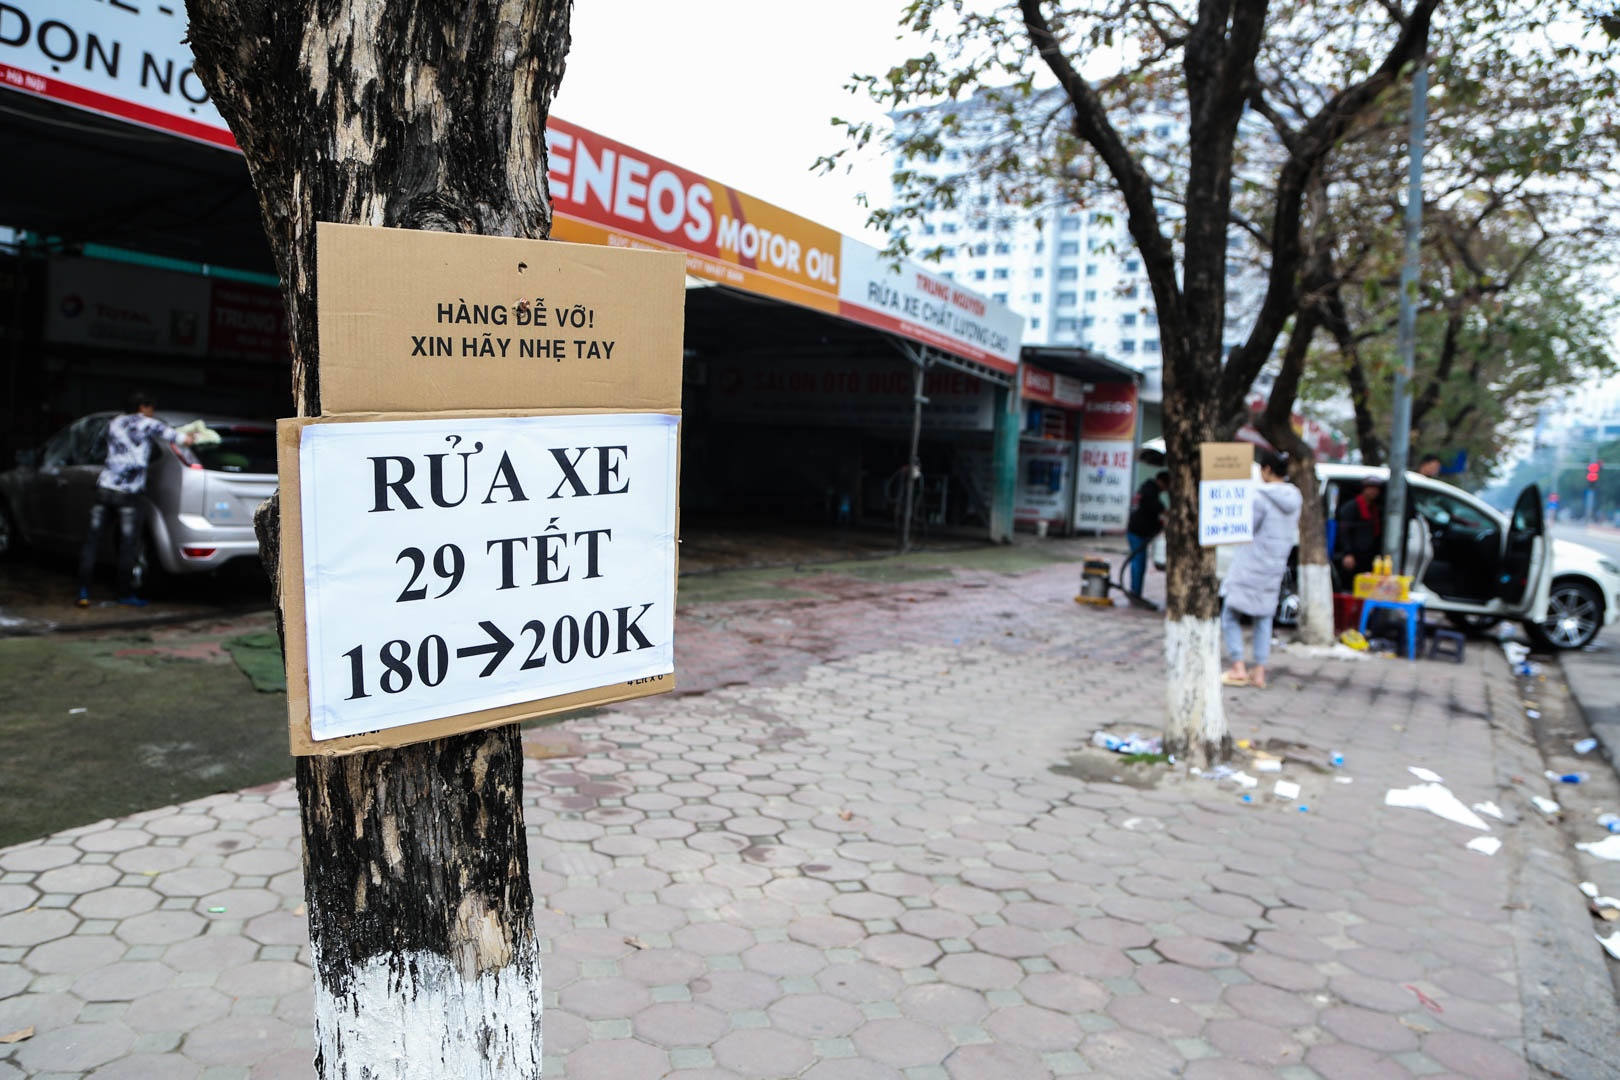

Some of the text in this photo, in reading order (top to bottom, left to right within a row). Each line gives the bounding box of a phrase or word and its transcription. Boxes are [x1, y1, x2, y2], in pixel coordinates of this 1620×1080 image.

[0, 3, 120, 79] DỌN
[546, 127, 838, 286] ENEOS MOTOR OIL
[437, 298, 508, 326] HÀNG
[555, 304, 595, 329] VỠ!
[902, 294, 921, 318] XE
[411, 332, 615, 363] XIN HÃY NHẸ TAY
[367, 435, 631, 513] RỬA XE
[395, 516, 612, 603] 29 TẾT
[341, 602, 656, 701] 180 200K
